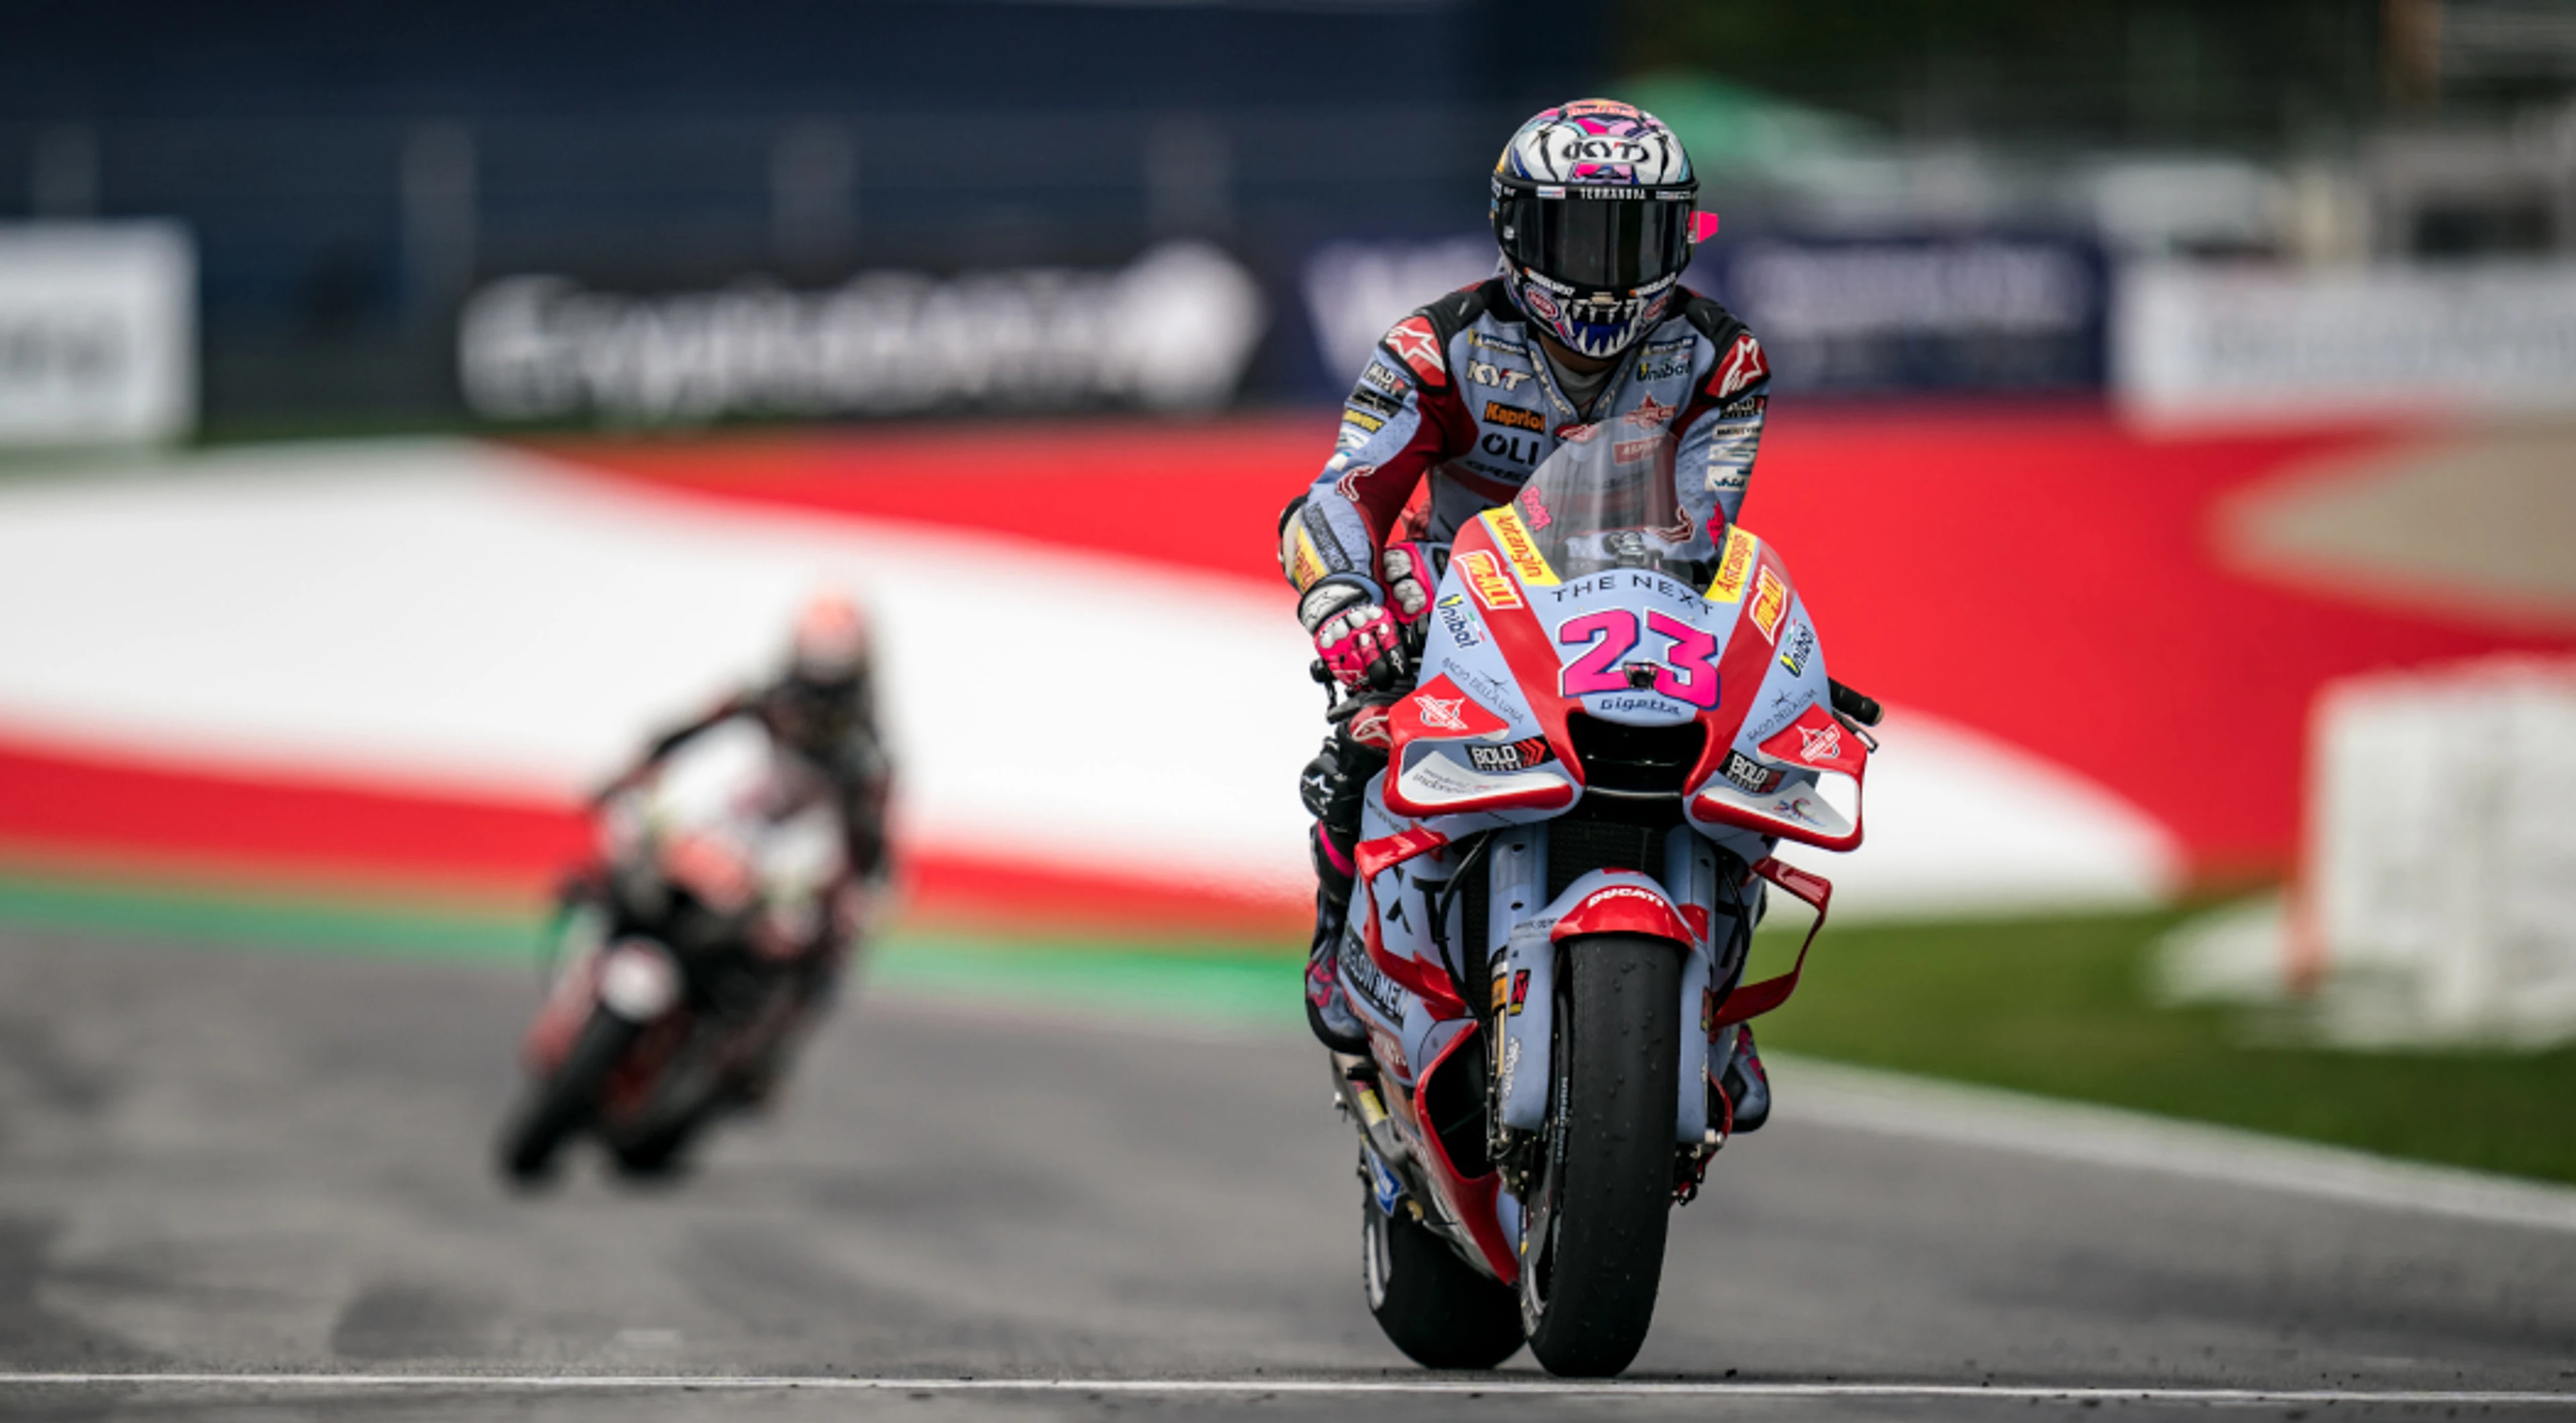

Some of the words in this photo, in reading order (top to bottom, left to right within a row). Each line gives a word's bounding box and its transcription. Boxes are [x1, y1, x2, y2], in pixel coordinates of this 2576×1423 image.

[1573, 140, 1644, 161] KYT
[1466, 359, 1535, 392] KYT
[1484, 401, 1546, 433] Kapriol
[1481, 432, 1540, 466] OLI
[1495, 514, 1544, 578] Antangin
[1550, 575, 1616, 602] THE
[1632, 574, 1714, 615] NEXT
[1437, 593, 1481, 649] Unibat
[1555, 606, 1721, 712] 23
[1599, 696, 1682, 717] Gigatta
[1470, 745, 1518, 765] BOLD
[1728, 753, 1770, 784] BOLD
[1587, 886, 1664, 908] DUCATI
